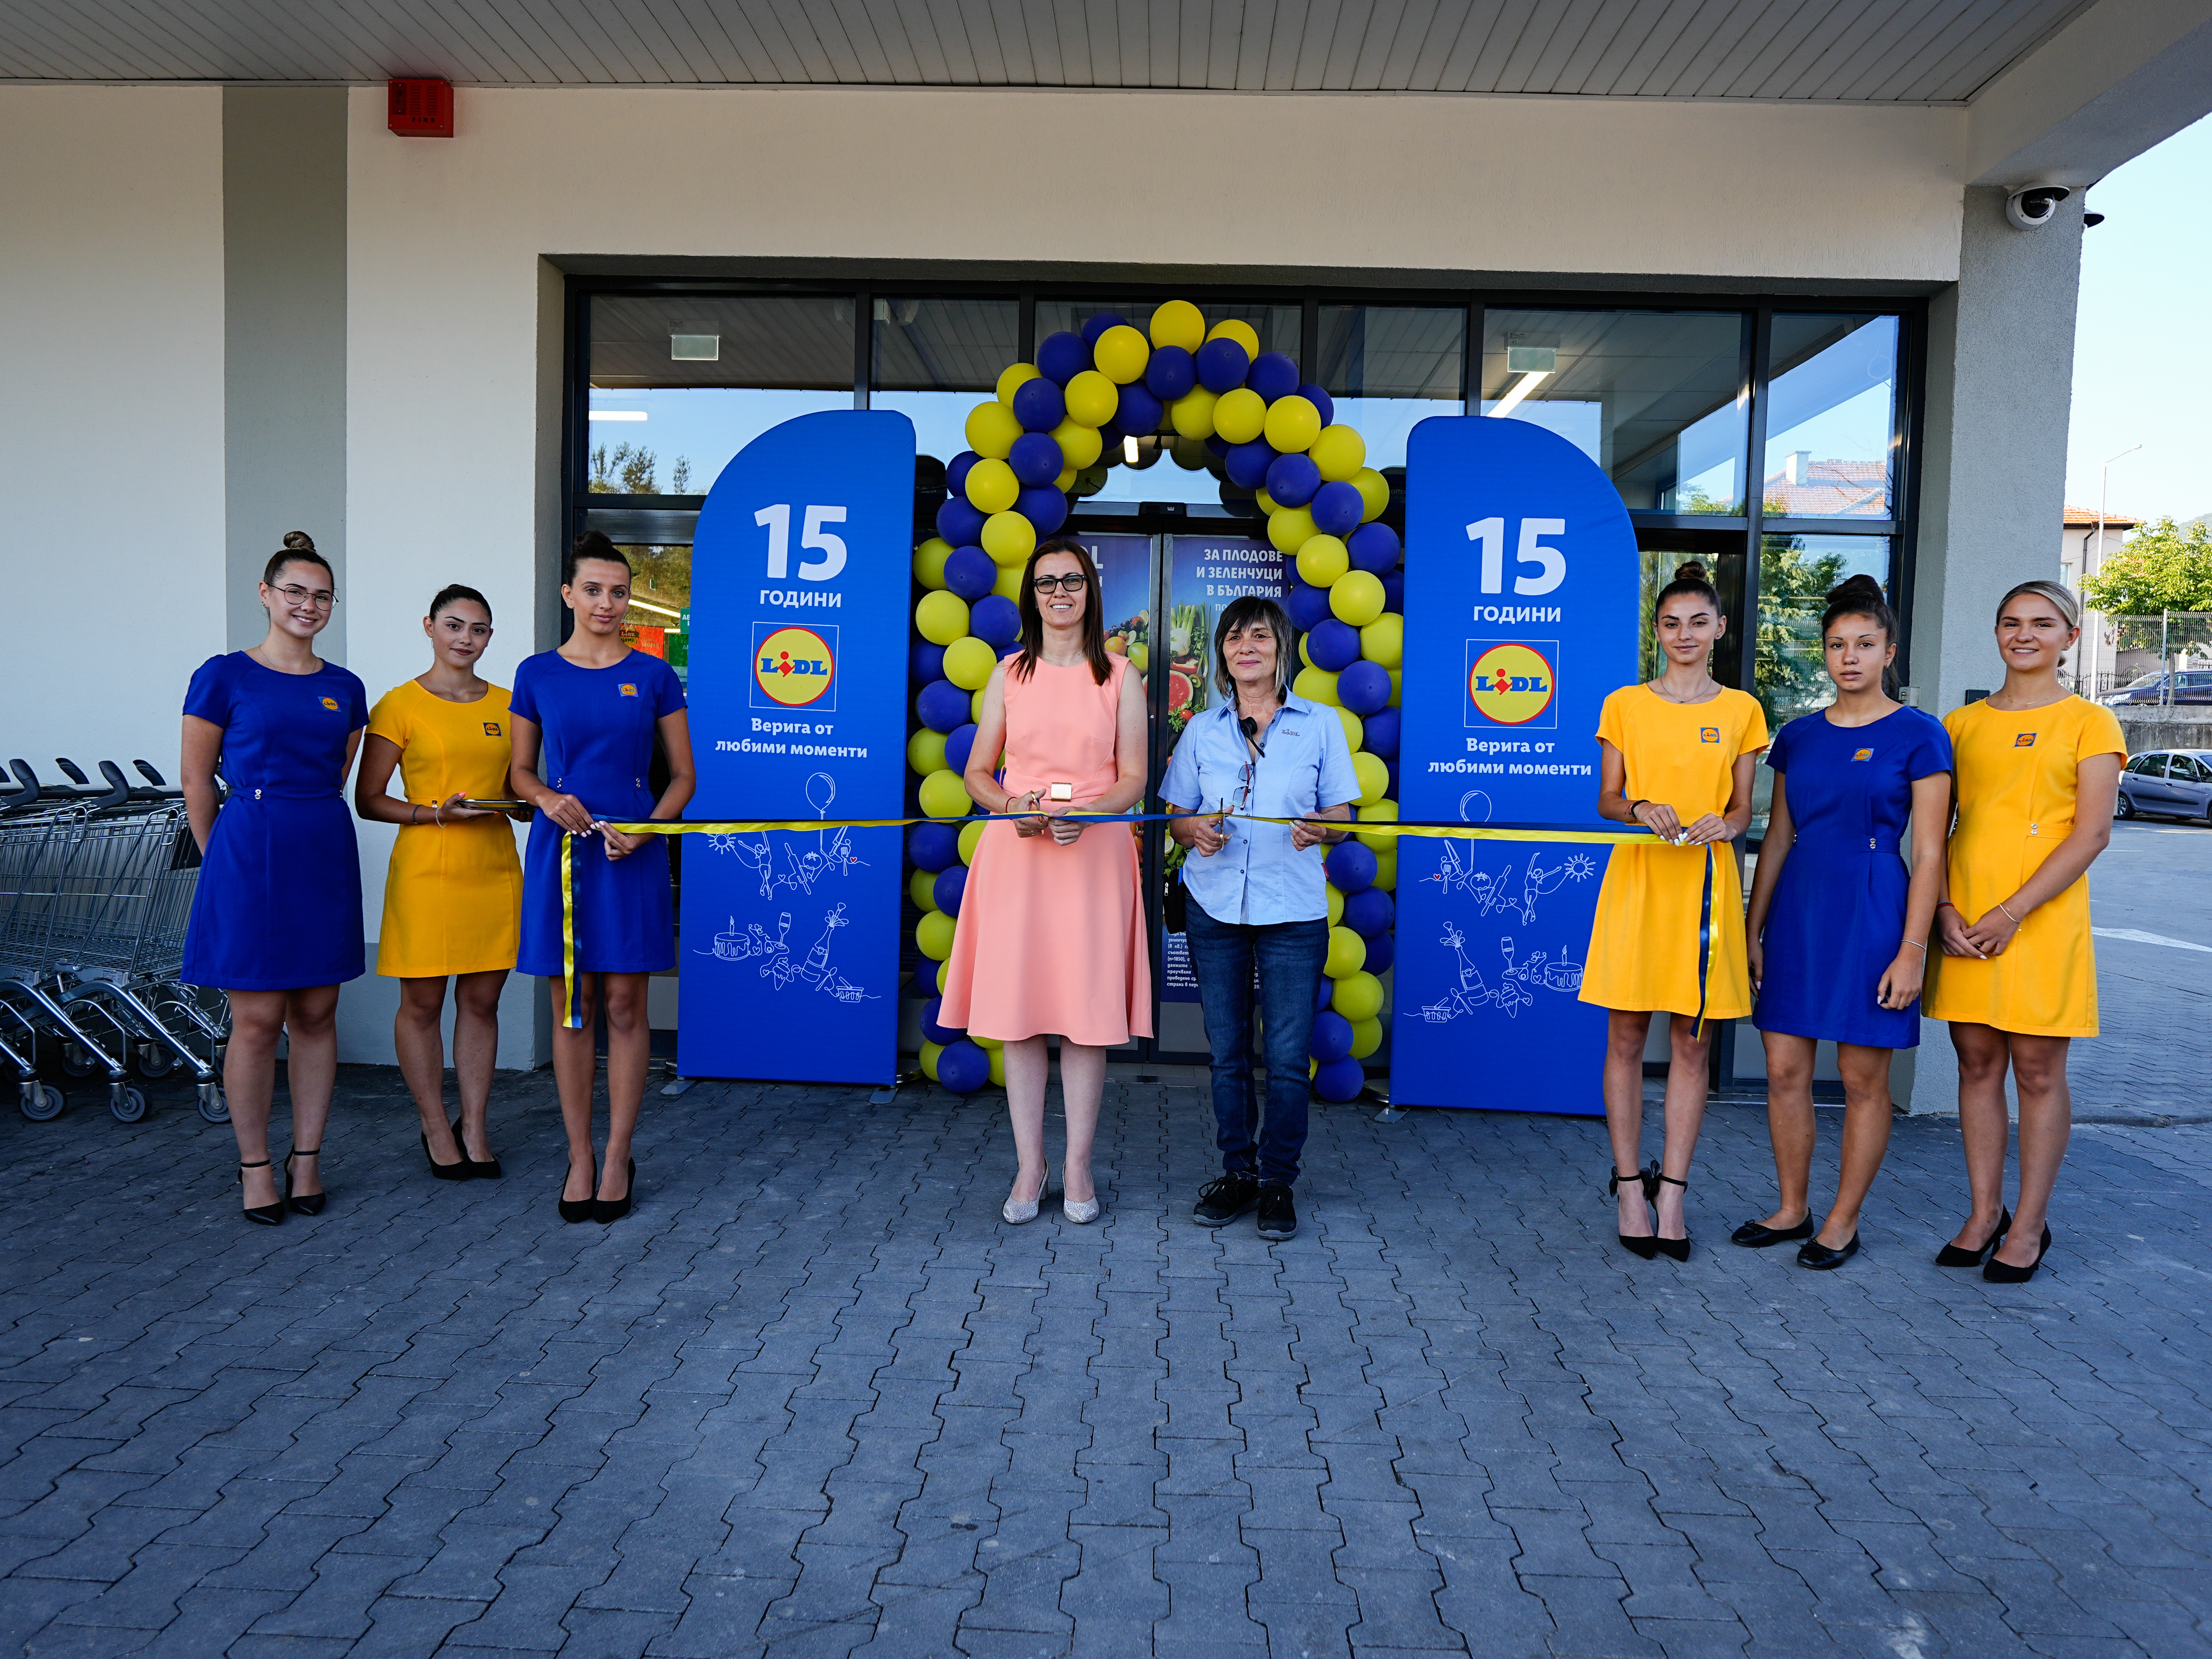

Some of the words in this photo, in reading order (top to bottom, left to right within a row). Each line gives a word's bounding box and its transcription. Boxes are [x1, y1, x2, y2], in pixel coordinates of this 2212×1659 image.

[754, 504, 847, 581] 15
[1204, 549, 1220, 561] ЗА
[1223, 549, 1283, 563] ПЛОДОВЕ
[1466, 517, 1567, 596] 15
[1196, 566, 1205, 578] И
[1208, 567, 1282, 582] ЗЕЛЕНЧУЦИ
[760, 590, 841, 608] ГОДИНИ
[1206, 585, 1214, 596] В
[1217, 585, 1282, 598] БЪЛГАРИЯ
[1473, 606, 1561, 624] ГОДИНИ
[761, 651, 827, 677] LIDL
[1476, 668, 1547, 696] LIDL
[751, 717, 811, 735] Верига
[815, 724, 834, 735] от
[715, 739, 786, 754] любими
[790, 745, 867, 758] моменти
[1466, 737, 1530, 755] Верига
[1534, 743, 1555, 753] от
[1428, 759, 1504, 774] любими
[1508, 764, 1591, 775] моменти
